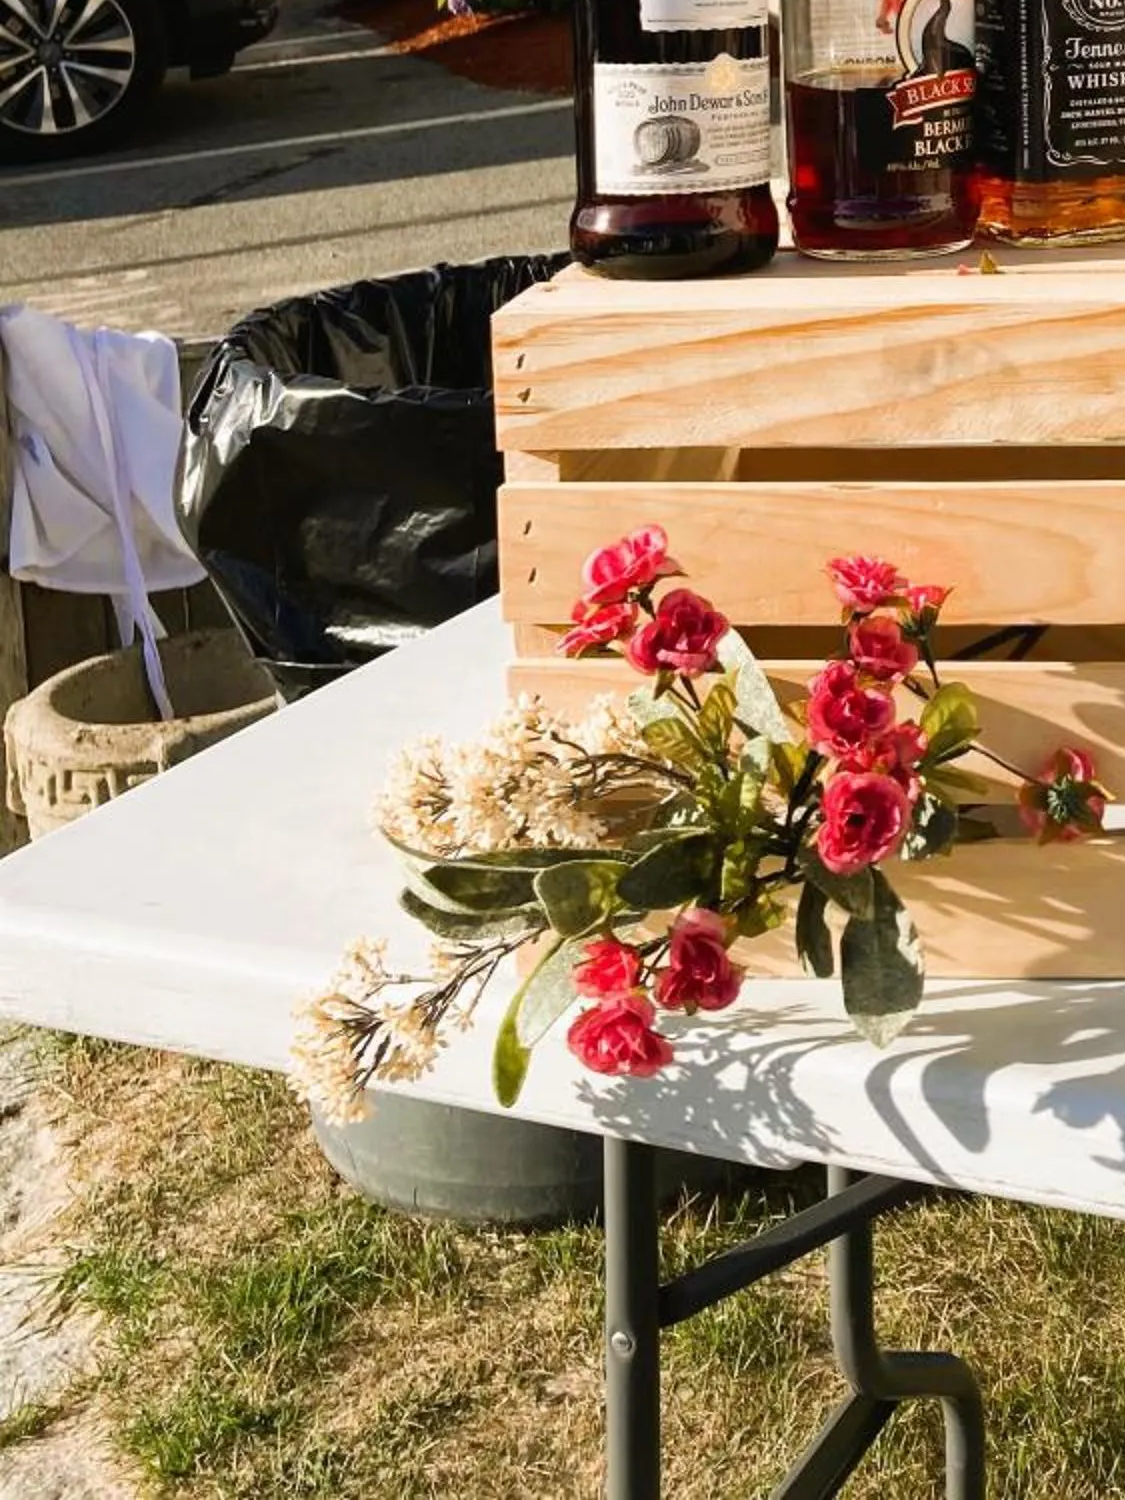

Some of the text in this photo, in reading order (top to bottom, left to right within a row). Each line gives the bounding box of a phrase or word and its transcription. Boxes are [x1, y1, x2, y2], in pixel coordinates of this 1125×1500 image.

[906, 79, 956, 105] BLACK
[648, 95, 687, 114] John
[690, 93, 734, 111] Dewar
[914, 137, 962, 157] BLACK
